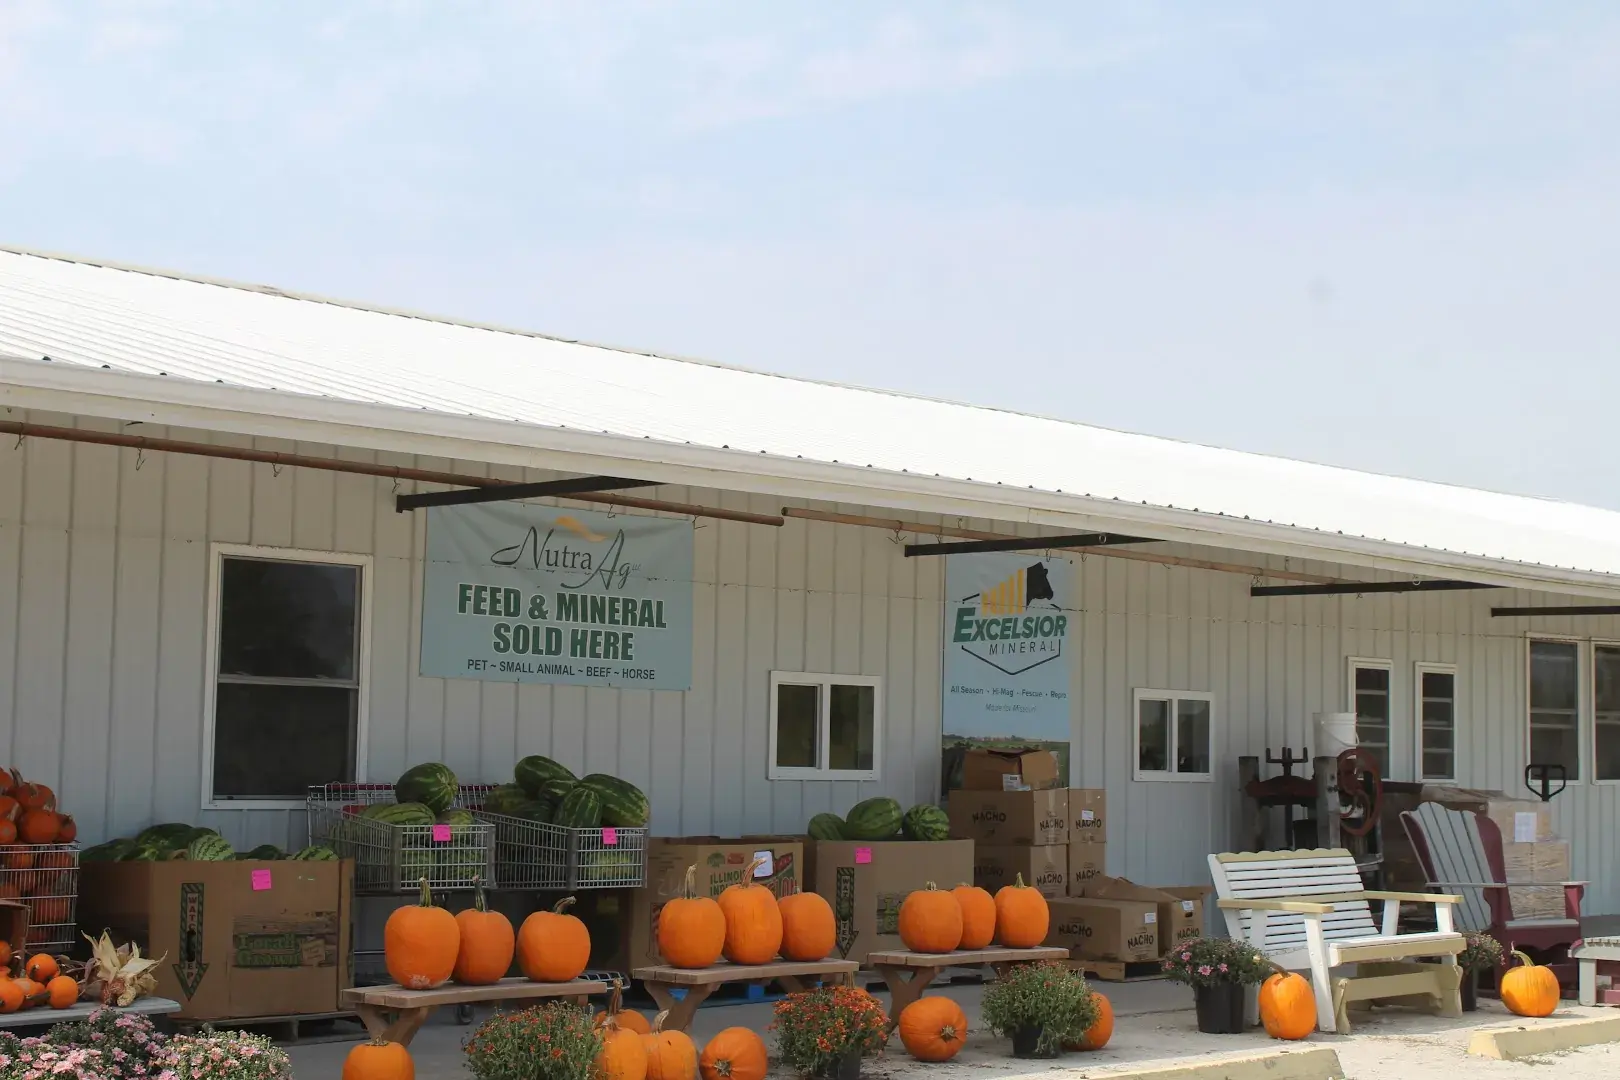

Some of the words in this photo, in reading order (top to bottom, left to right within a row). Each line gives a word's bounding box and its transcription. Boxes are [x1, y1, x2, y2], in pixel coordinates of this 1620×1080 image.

[491, 526, 593, 569] Nutra
[560, 529, 632, 590] Ag
[458, 583, 521, 618] FEED
[528, 594, 549, 620] &
[556, 592, 667, 628] MINERAL
[953, 607, 1067, 643] EXCELSIOR
[493, 622, 563, 656] SOLD
[569, 628, 634, 661] HERE
[989, 641, 1055, 655] MINERAL
[467, 659, 488, 671] PET
[499, 660, 534, 674] SMALL
[537, 663, 575, 676] ANIMAL
[586, 666, 611, 678] BEEF
[622, 668, 655, 680] HORSE
[950, 685, 960, 694] All
[960, 686, 984, 695] Season
[992, 688, 1014, 698] Hi-Mag
[1022, 689, 1043, 698] Fescue
[1050, 690, 1067, 699] Repro
[972, 811, 1007, 825] NACHO
[1039, 818, 1064, 831] NACHO
[1036, 873, 1063, 886] NACHO
[1058, 925, 1093, 938] NACHO
[1177, 928, 1200, 941] NACHO
[1127, 934, 1154, 949] NACHO
